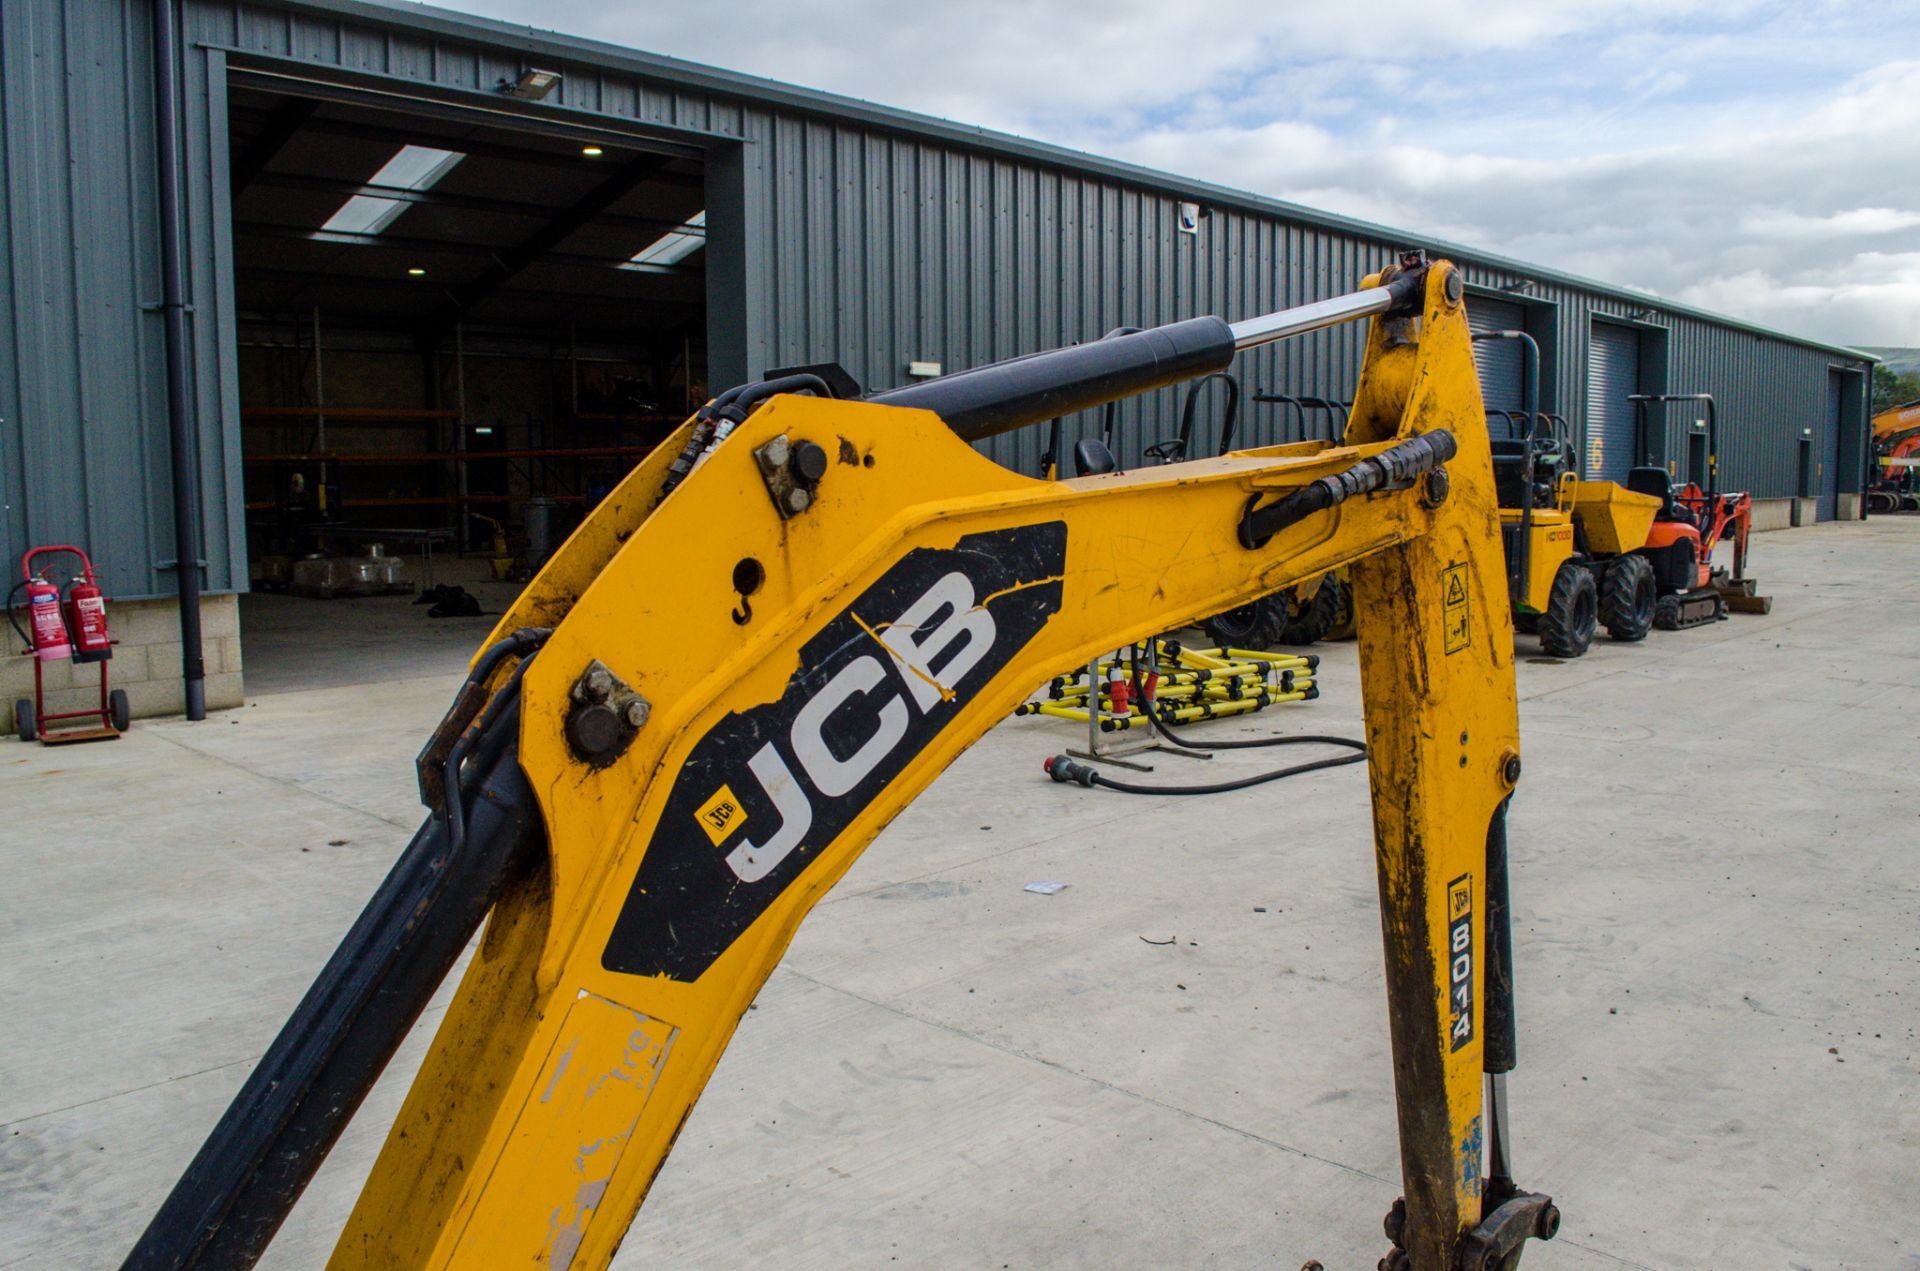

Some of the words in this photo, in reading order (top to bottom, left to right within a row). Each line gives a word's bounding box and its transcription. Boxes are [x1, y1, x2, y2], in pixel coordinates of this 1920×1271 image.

[725, 571, 997, 883] JCB
[709, 802, 734, 828] JCB
[1454, 890, 1468, 913] JCB
[1452, 922, 1471, 1038] 8014
